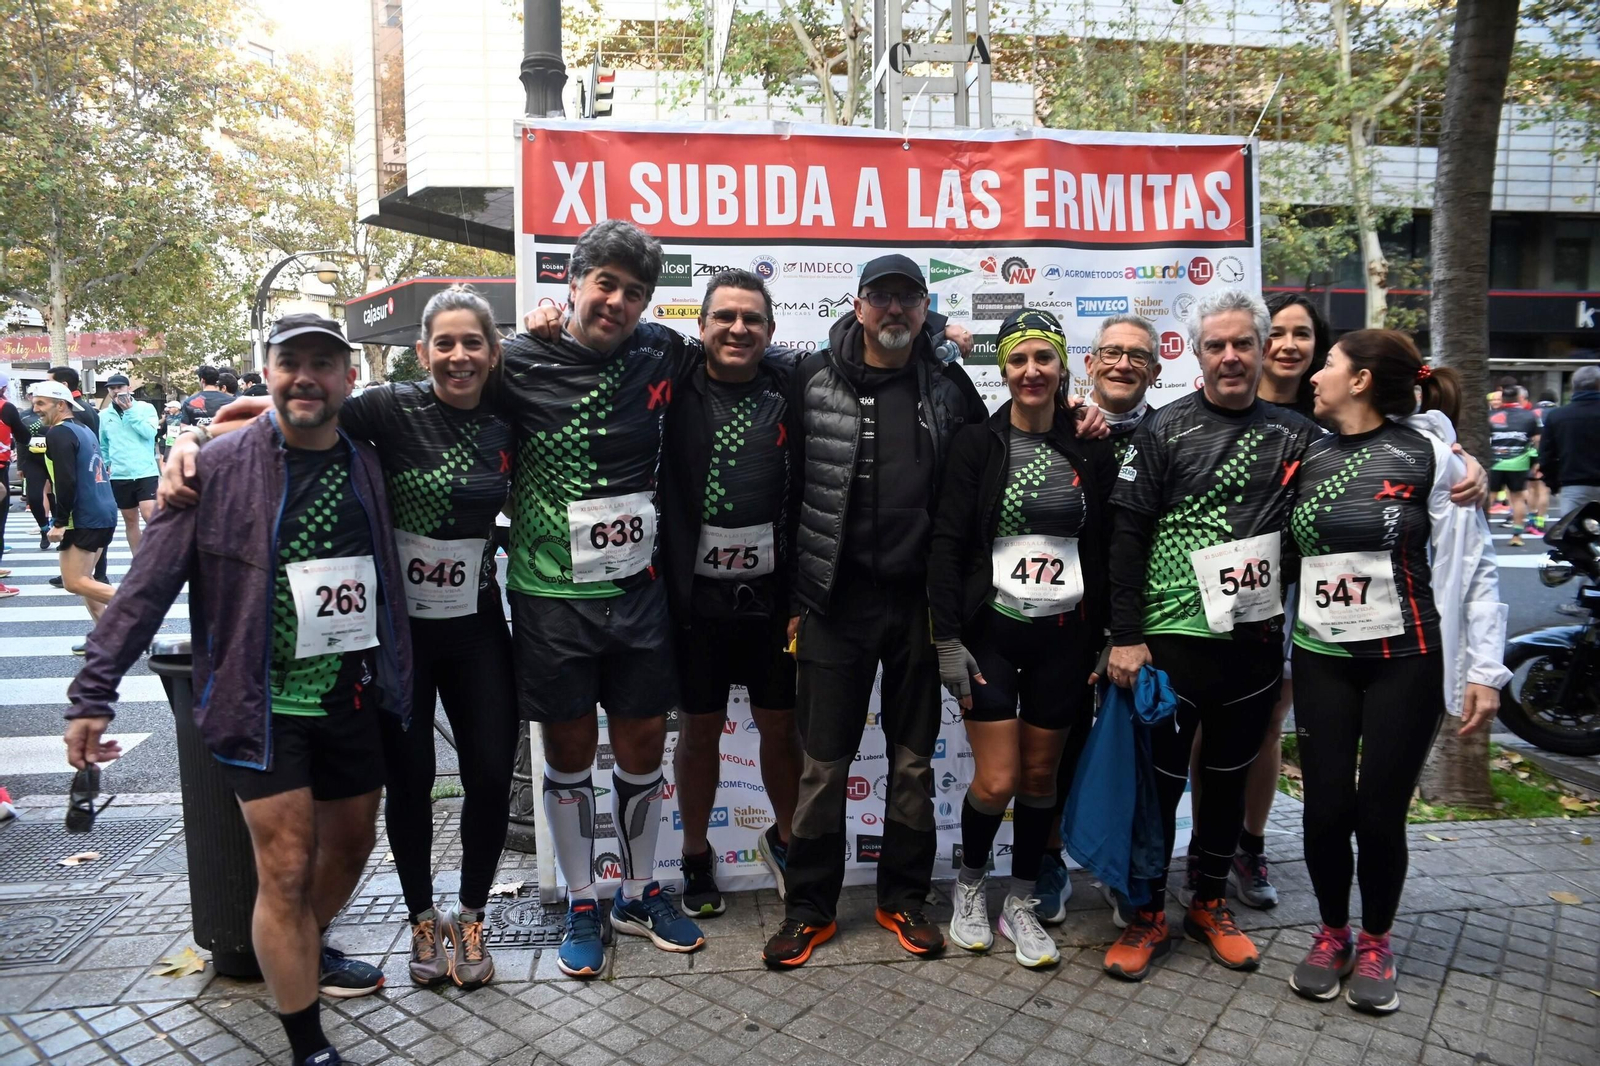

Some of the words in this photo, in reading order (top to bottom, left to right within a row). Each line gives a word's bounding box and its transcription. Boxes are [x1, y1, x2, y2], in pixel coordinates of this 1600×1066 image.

[552, 160, 608, 225] XI
[629, 161, 836, 227] SUBIDA
[852, 167, 887, 228] A
[907, 167, 1001, 230] LAS
[1023, 167, 1232, 232] ERMITAS
[800, 262, 853, 273] IMDECO
[1009, 269, 1036, 284] NLV
[1065, 269, 1123, 279] AGROMÉTODOS
[1124, 260, 1186, 280] acuerdo
[1078, 300, 1127, 311] PINVECO
[1134, 296, 1163, 306] Sabor
[363, 303, 389, 327] cajasur
[3, 342, 31, 359] Feliz
[590, 516, 644, 549] 638
[703, 546, 759, 570] 475
[407, 558, 466, 588] 646
[1010, 557, 1066, 585] 472
[1219, 559, 1271, 596] 548
[316, 582, 366, 617] 263
[1315, 576, 1372, 608] 547
[719, 753, 756, 767] VEOLIA
[734, 805, 768, 816] Sabor
